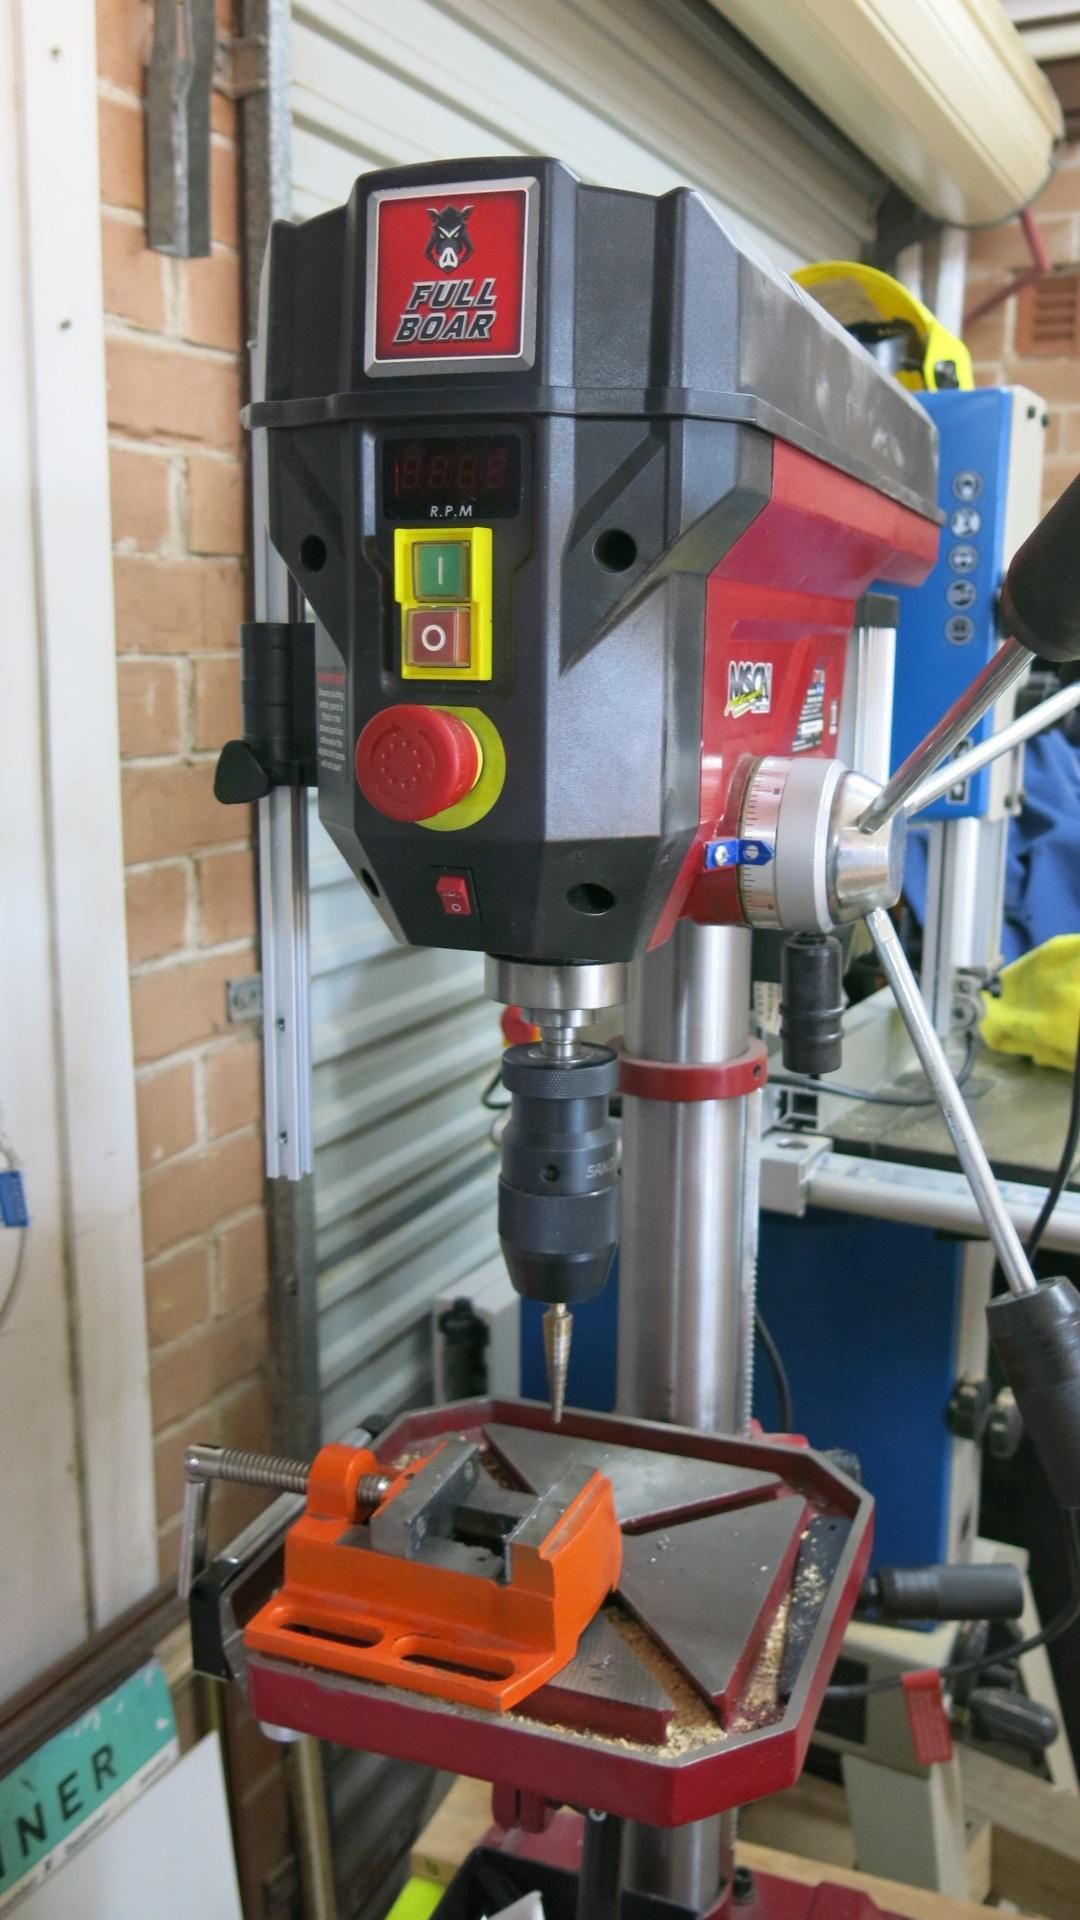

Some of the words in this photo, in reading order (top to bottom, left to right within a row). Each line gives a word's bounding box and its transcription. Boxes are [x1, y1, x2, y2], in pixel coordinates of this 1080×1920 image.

[407, 278, 497, 311] FULL
[393, 311, 497, 343] BOAR
[430, 505, 472, 518] R.P.M
[0, 1744, 118, 1878] NER
